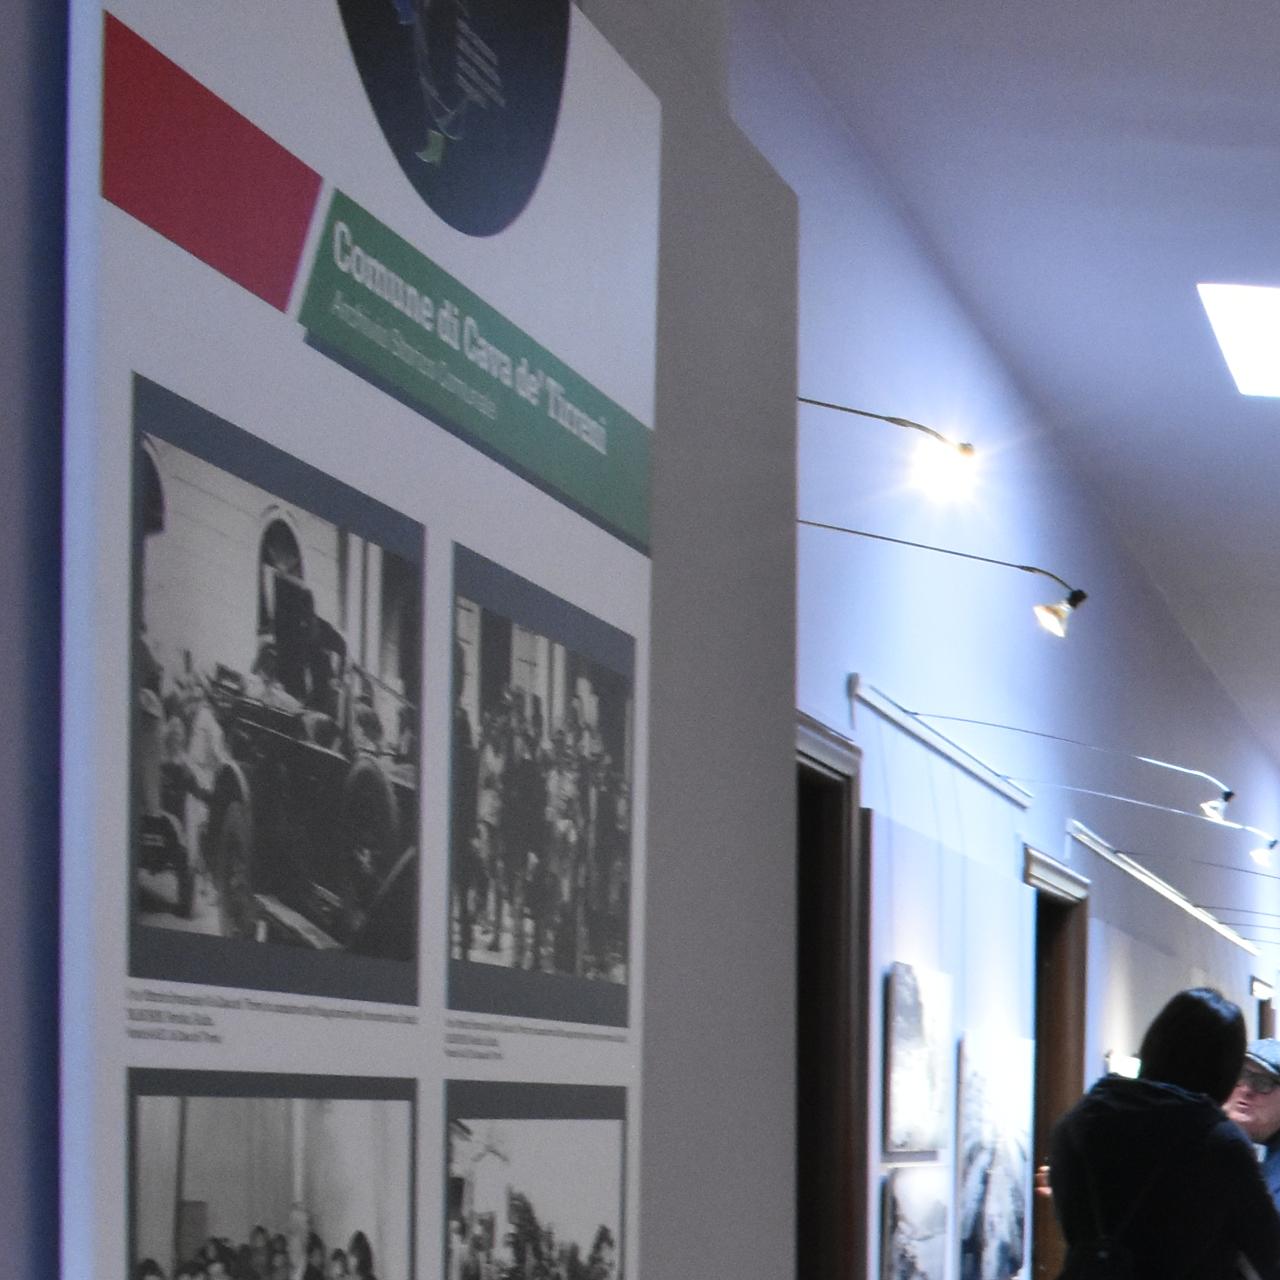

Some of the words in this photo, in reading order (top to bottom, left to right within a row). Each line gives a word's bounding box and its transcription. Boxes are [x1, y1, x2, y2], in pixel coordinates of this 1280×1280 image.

[333, 219, 434, 333] Comune
[436, 299, 461, 351] di
[462, 314, 513, 389] Cava
